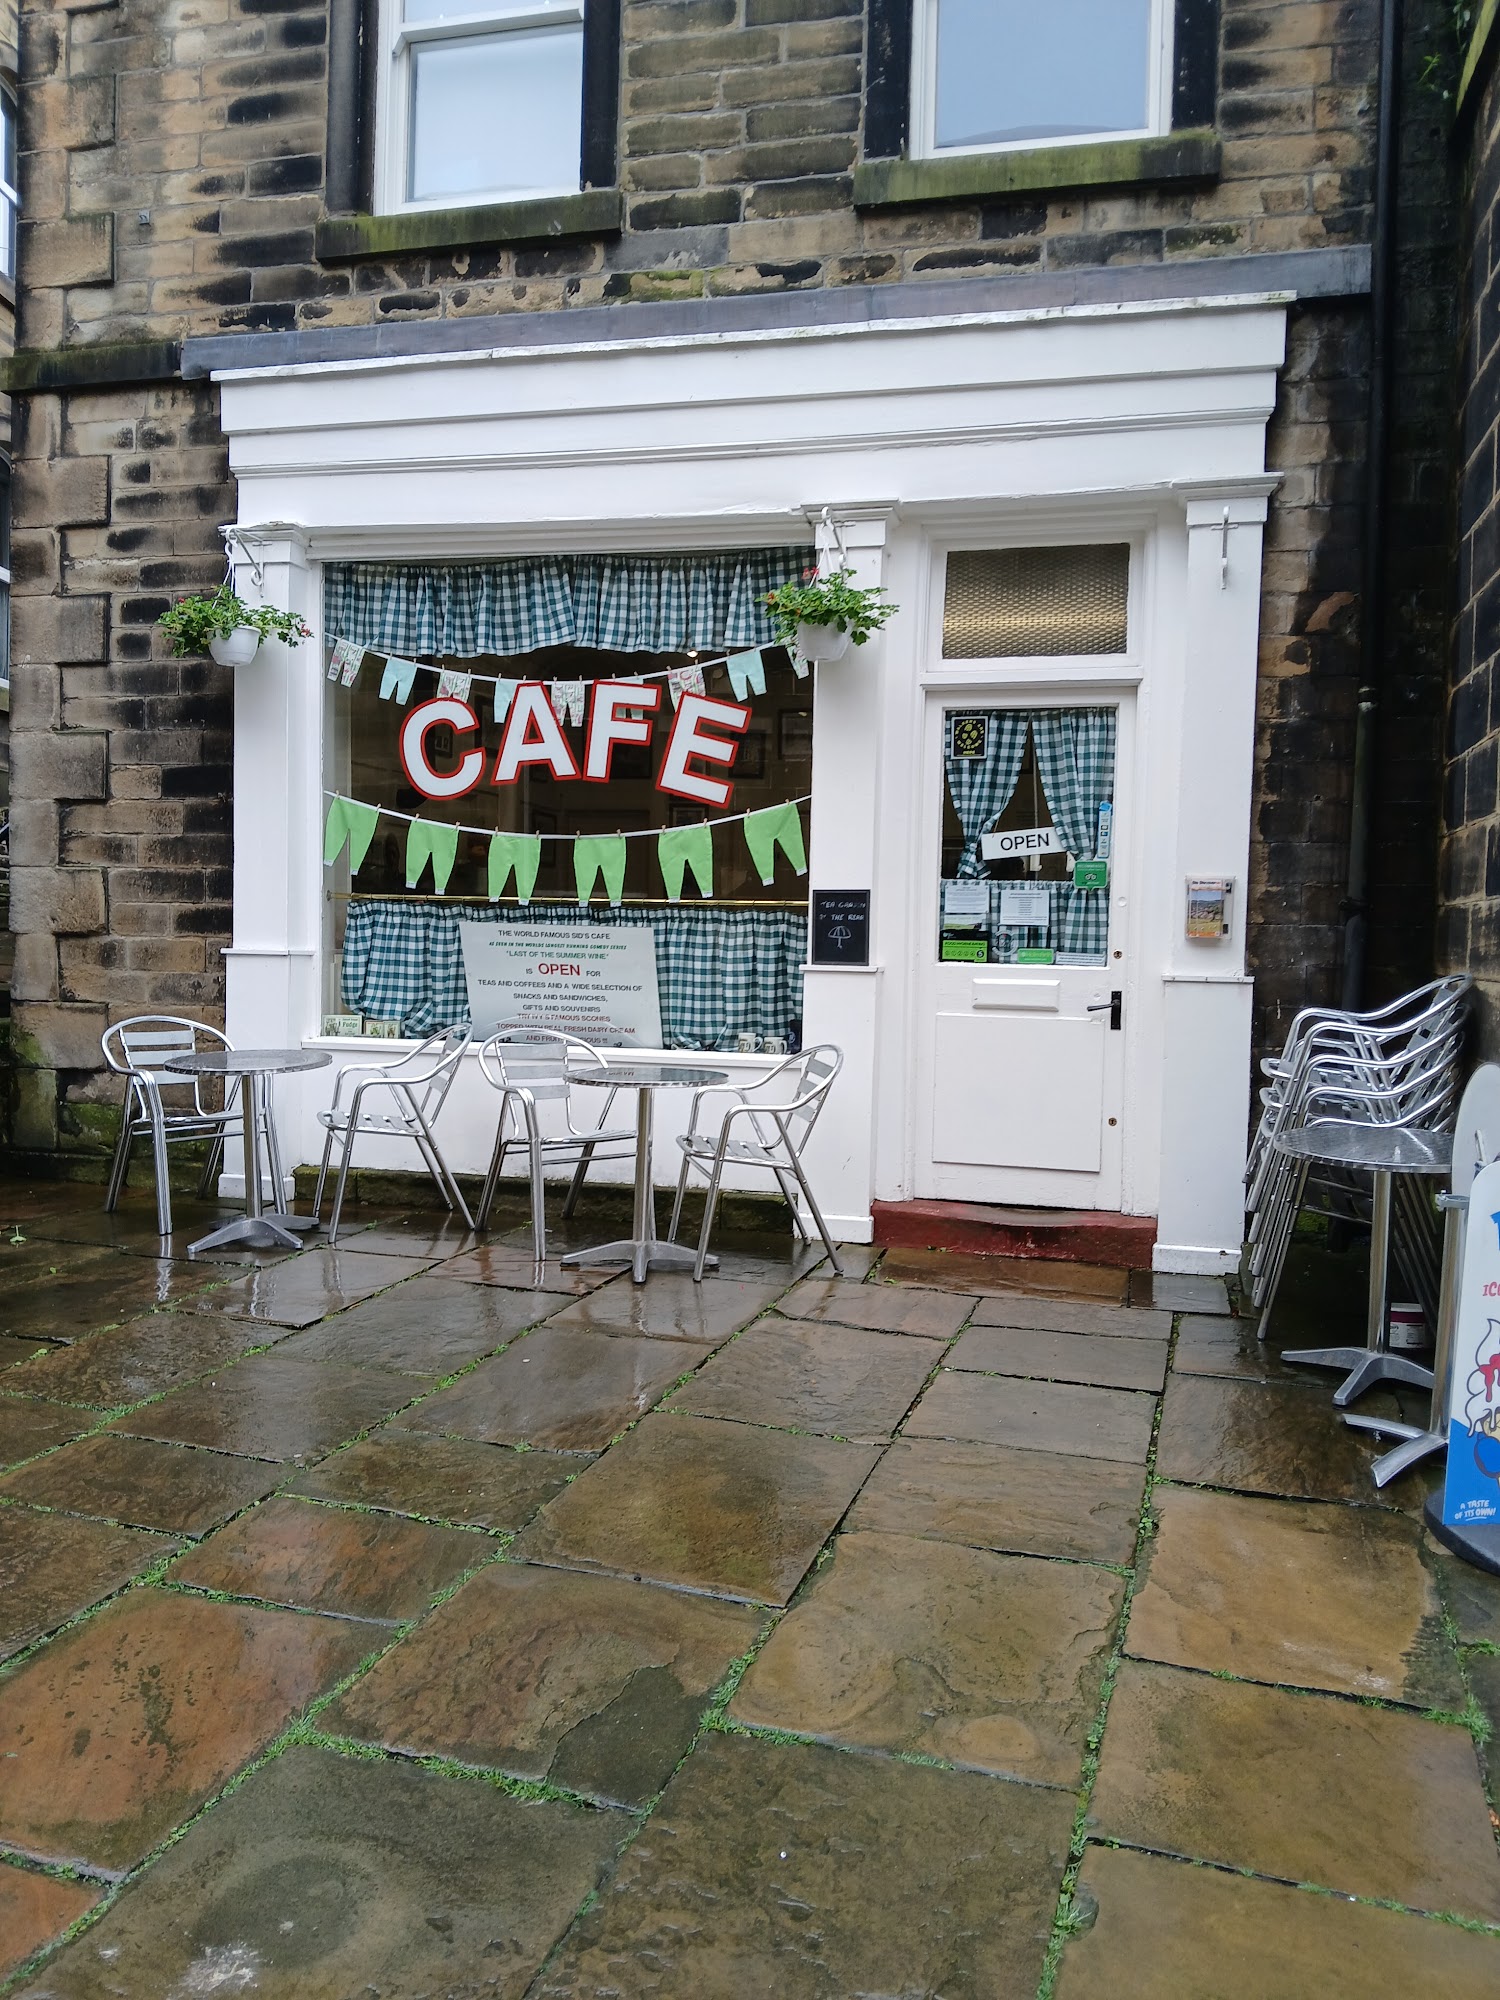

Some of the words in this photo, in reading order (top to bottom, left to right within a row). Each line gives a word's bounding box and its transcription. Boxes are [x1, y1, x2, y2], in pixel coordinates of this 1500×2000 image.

[399, 680, 752, 808] CAFE
[1000, 832, 1050, 850] OPEN
[538, 963, 580, 976] OPEN
[1467, 1500, 1490, 1508] TASTE
[1475, 1508, 1496, 1516] OWN!
